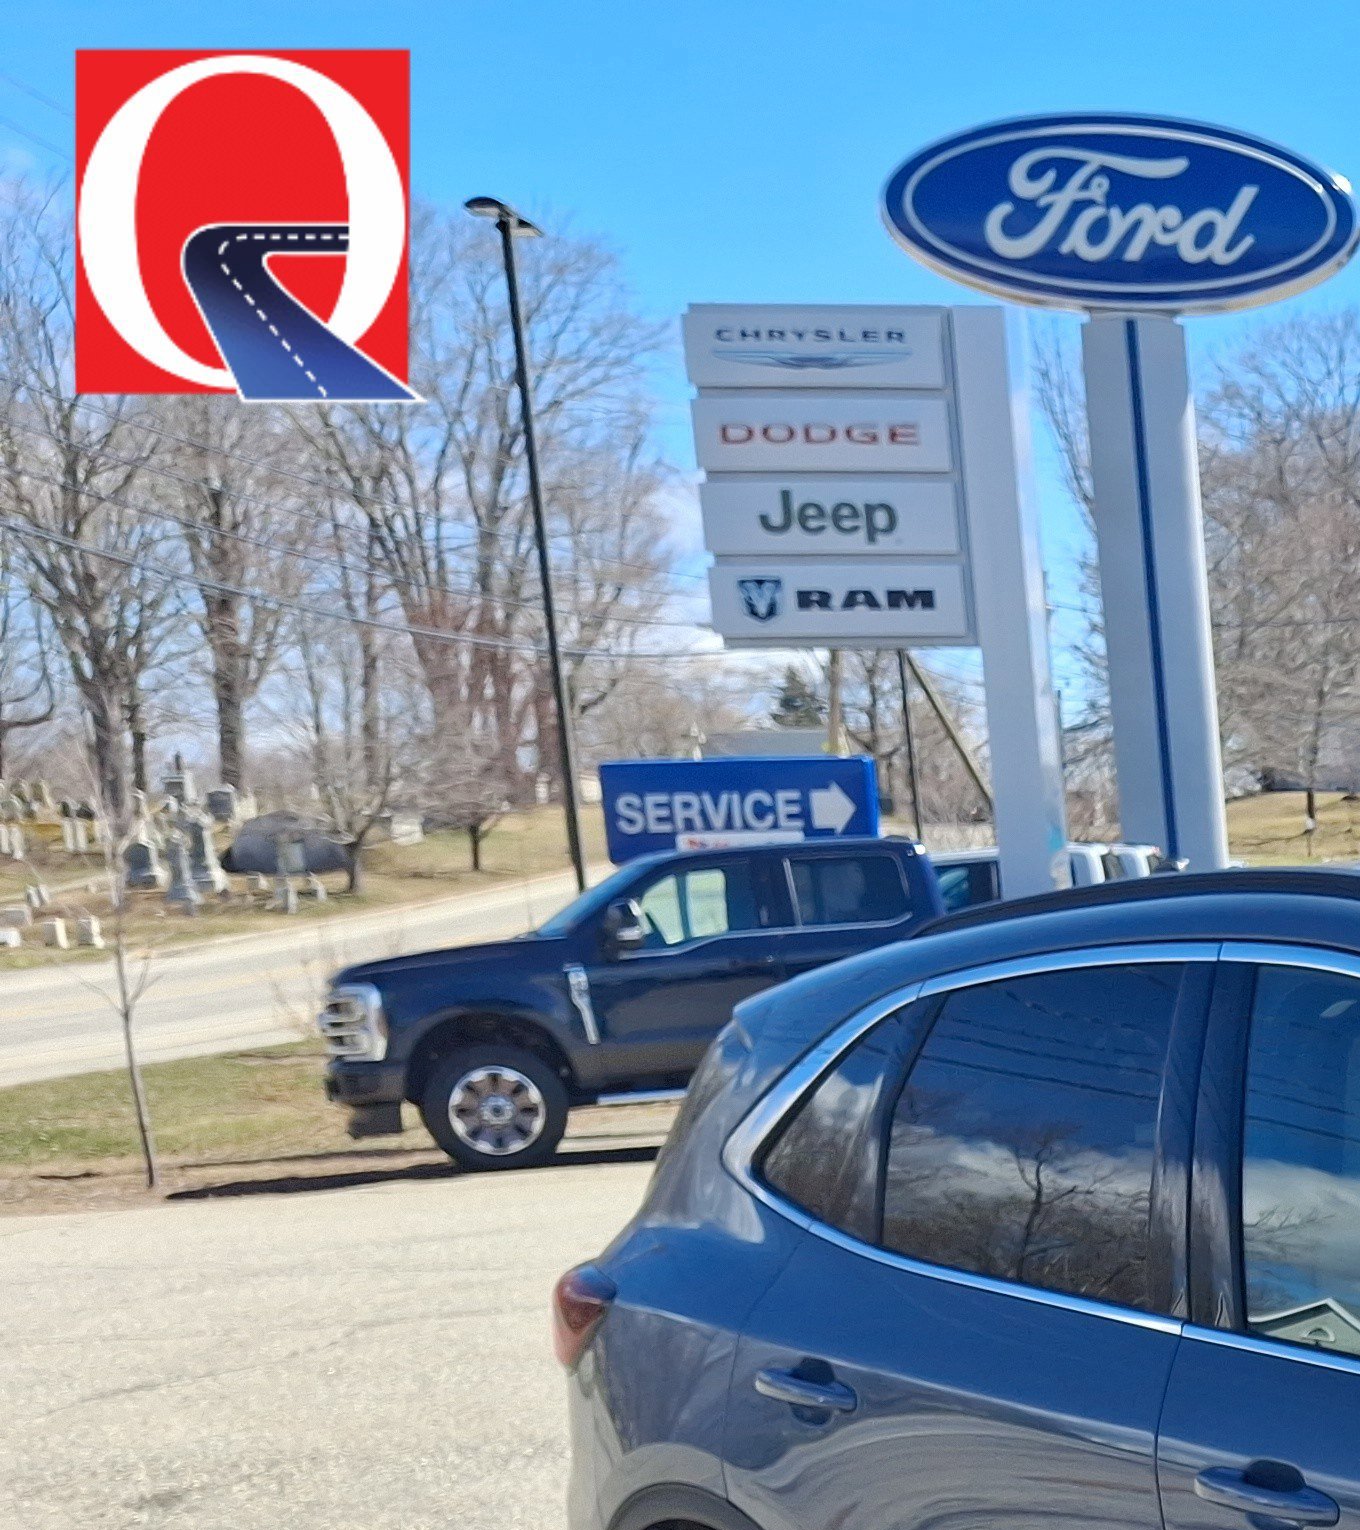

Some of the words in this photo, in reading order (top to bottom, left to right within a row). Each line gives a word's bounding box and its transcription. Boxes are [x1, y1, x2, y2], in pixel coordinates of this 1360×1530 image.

[983, 146, 1260, 266] Ford
[715, 327, 906, 344] CHRYSLER
[719, 422, 921, 446] DODGE
[758, 489, 899, 544] Jeep
[796, 589, 936, 611] RAM
[614, 788, 805, 836] SERVICE
